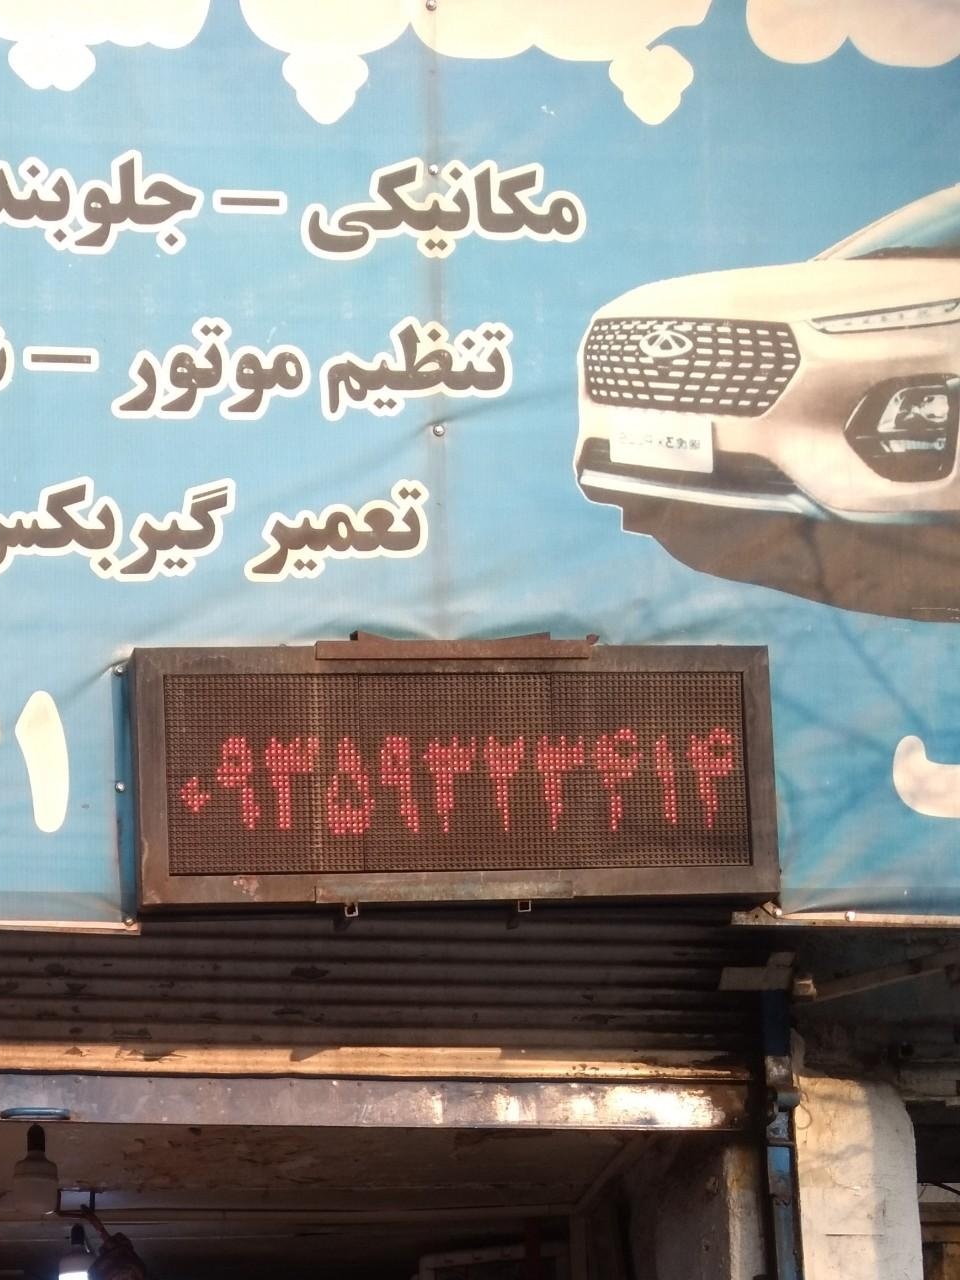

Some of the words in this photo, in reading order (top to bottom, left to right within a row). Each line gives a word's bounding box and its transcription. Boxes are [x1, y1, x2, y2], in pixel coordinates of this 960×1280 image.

[306, 162, 581, 255] مکانیکی
[117, 322, 305, 415] موتور
[326, 322, 507, 416] تنظیم
[250, 485, 423, 577] تعمیر
